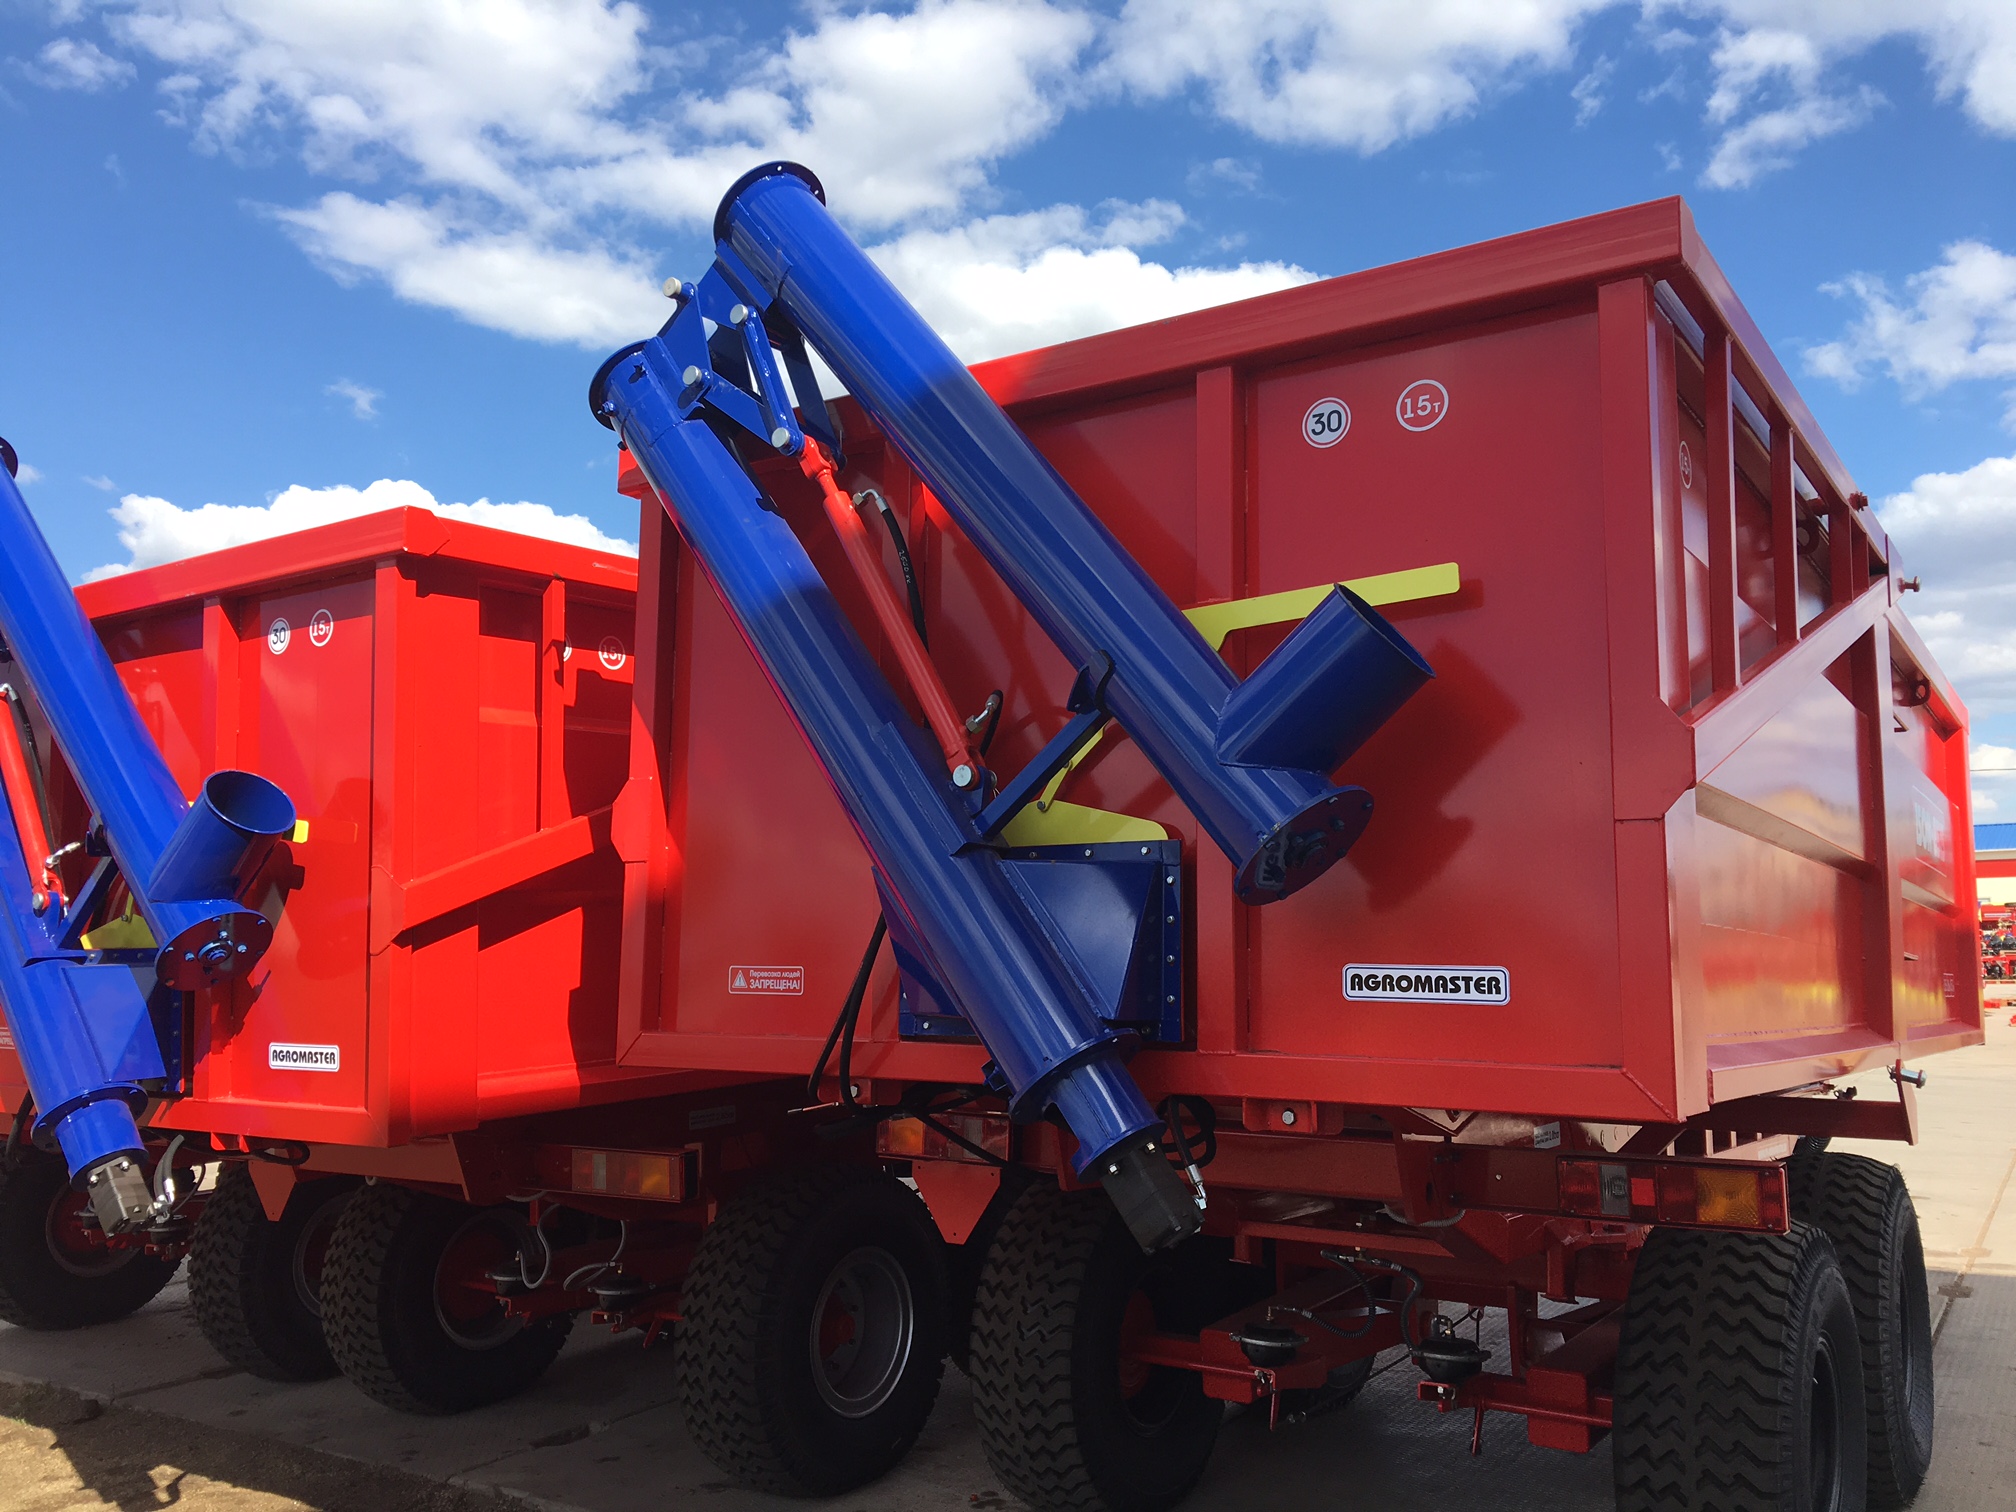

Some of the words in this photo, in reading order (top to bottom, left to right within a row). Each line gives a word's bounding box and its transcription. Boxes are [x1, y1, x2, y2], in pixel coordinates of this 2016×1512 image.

[1311, 409, 1343, 436] 30
[272, 627, 287, 645] 30
[749, 969, 781, 978] Перевозка
[782, 970, 800, 978] людей
[749, 979, 800, 991] ЗАПРЕЩЕНА!
[1350, 973, 1502, 995] AGROMASTER
[272, 1049, 336, 1065] AGROMASTER
